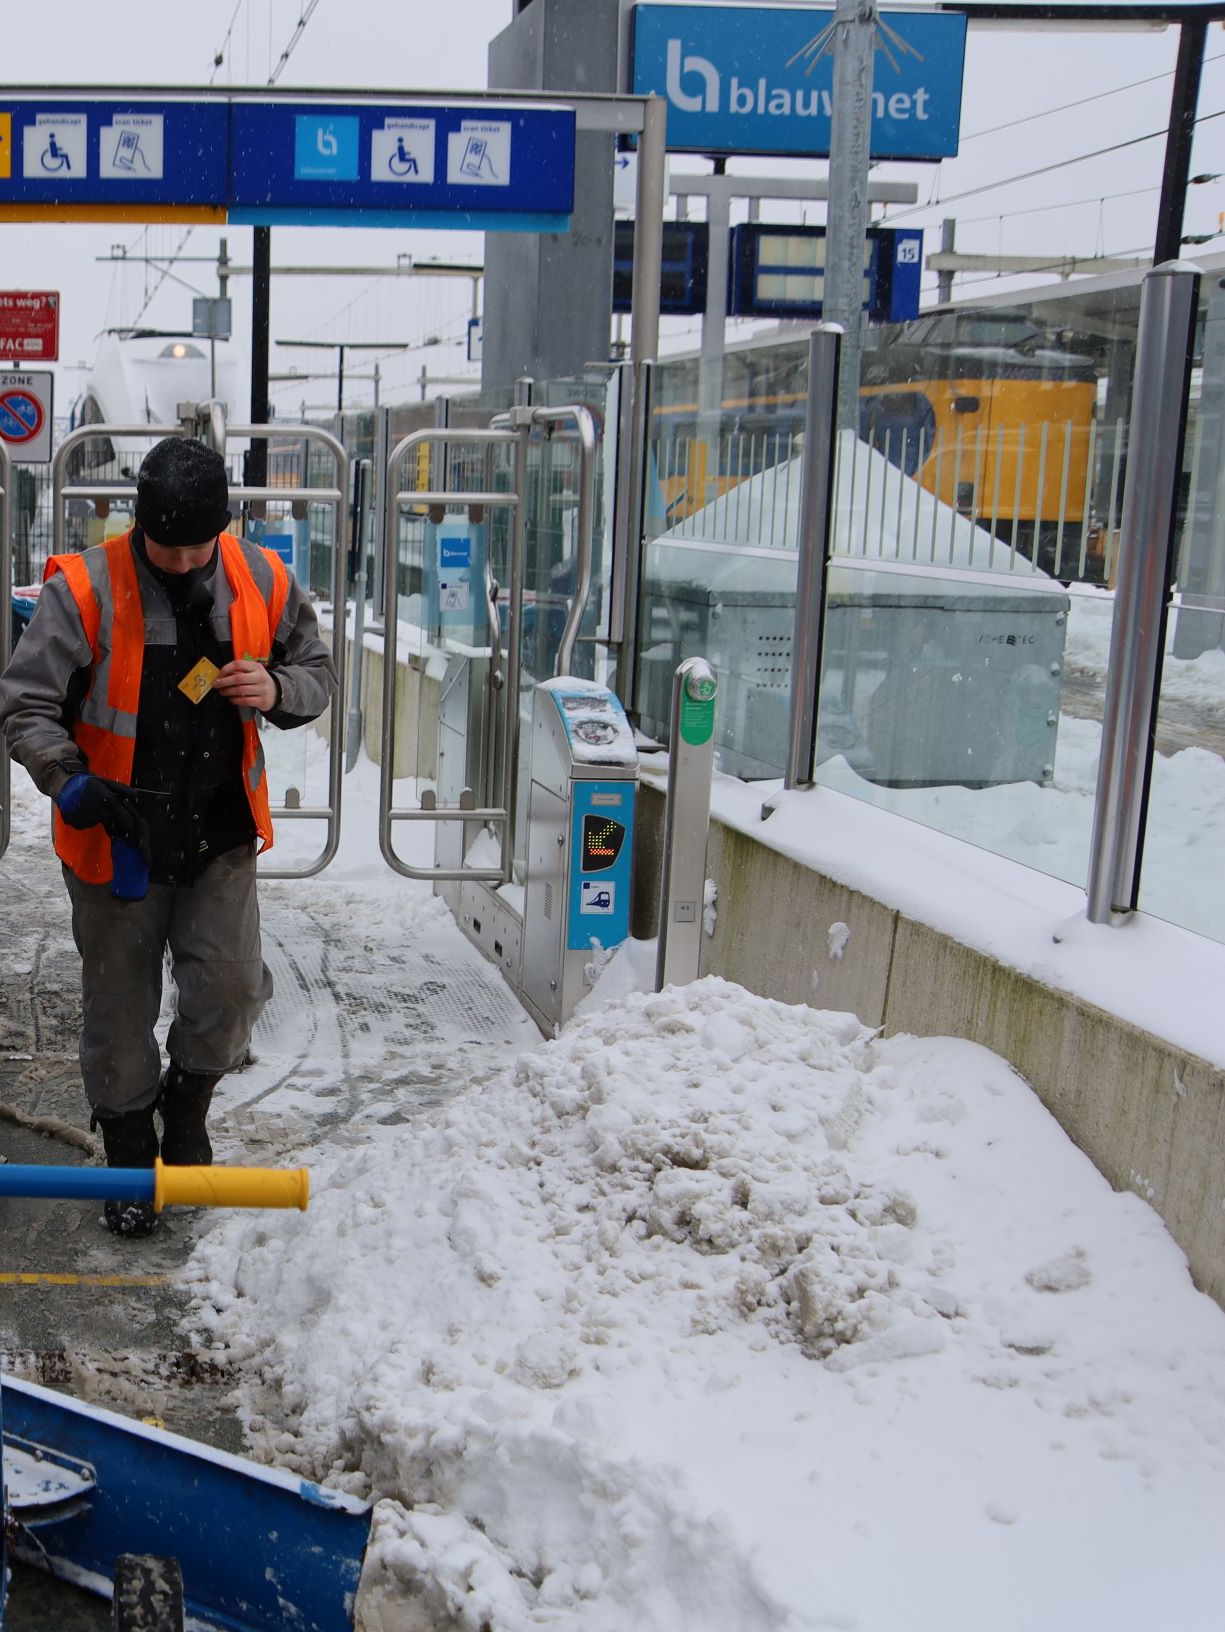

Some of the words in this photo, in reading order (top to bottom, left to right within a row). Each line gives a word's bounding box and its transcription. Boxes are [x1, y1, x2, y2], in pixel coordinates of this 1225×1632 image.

[729, 77, 930, 122] blaunet
[901, 248, 916, 260] 15
[16, 296, 46, 309] weg?
[1, 375, 33, 385] ZONE
